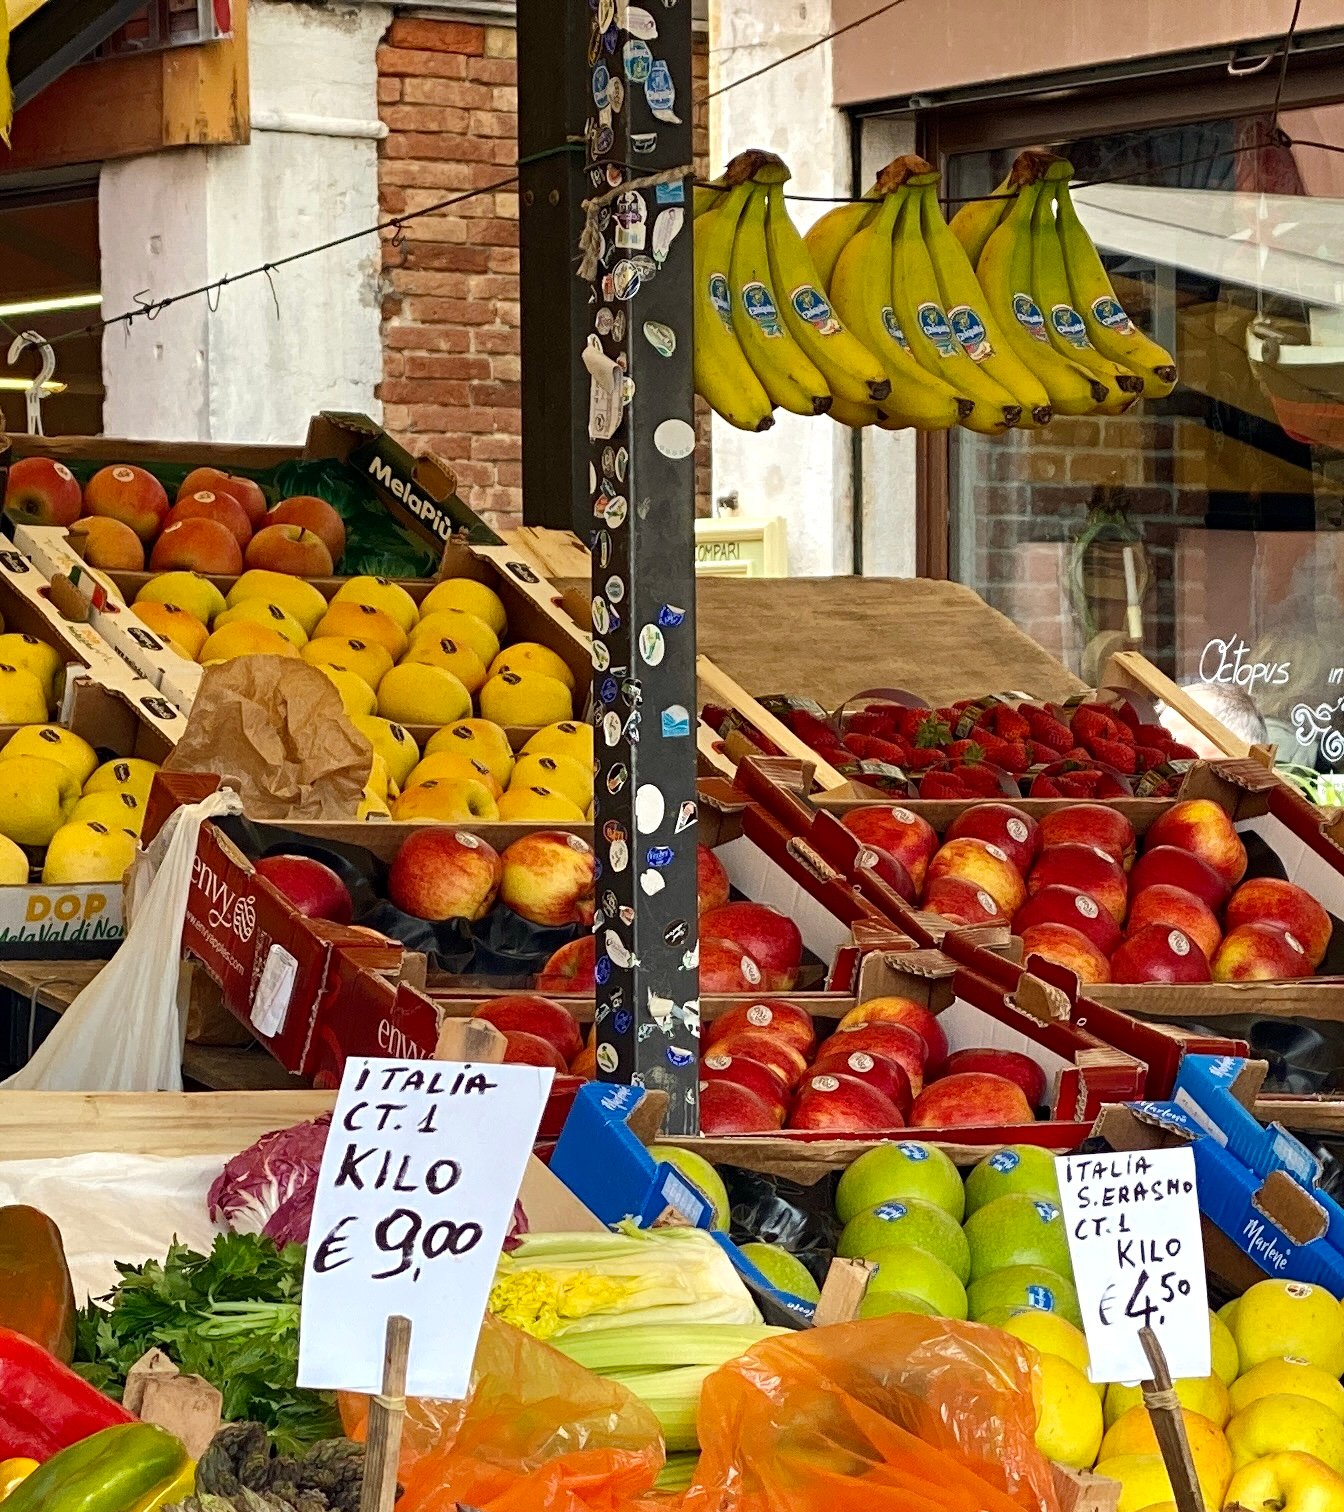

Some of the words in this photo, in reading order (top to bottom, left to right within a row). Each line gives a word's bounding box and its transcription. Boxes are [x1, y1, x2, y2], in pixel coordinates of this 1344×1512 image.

[369, 456, 453, 541] MelaPiù
[695, 543, 741, 562] OMPARI
[334, 1143, 463, 1195] KILO
[1118, 1238, 1182, 1269] KILO
[1242, 1219, 1289, 1270] Marlene
